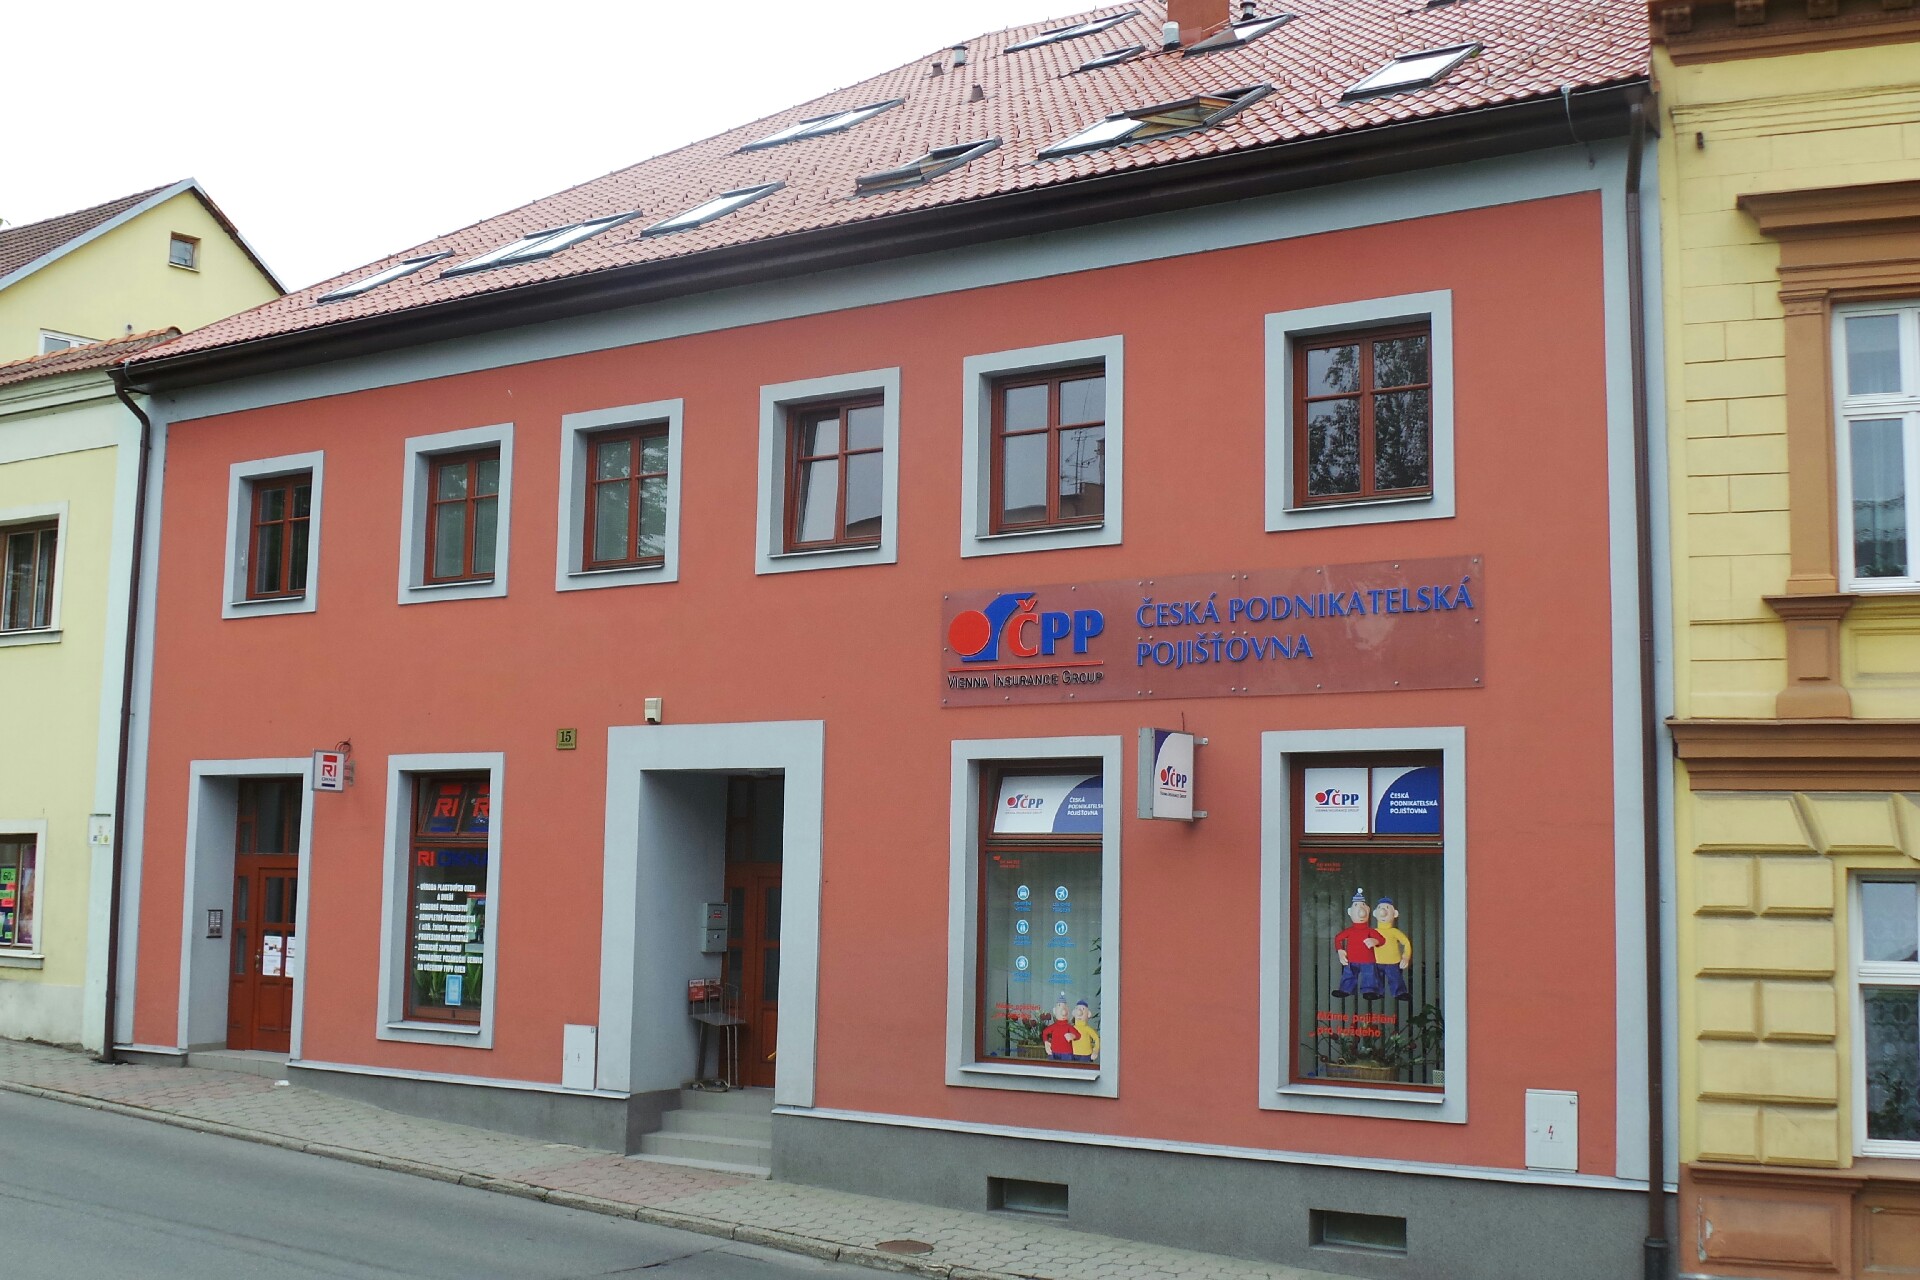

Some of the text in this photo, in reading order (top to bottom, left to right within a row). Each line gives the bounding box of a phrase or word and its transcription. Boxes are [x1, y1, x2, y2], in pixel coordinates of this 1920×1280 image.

[1135, 575, 1474, 628] ČESKÁ PODNIKATELSKÁ
[1007, 599, 1105, 657] ČPP
[1136, 631, 1314, 669] POJIŠŤOVNA
[947, 670, 1104, 689] VIENNA INSURANCE GROUP
[560, 730, 572, 743] 15
[322, 764, 337, 778] RI
[1170, 768, 1188, 789] ČPP
[1020, 795, 1044, 809] ČPP
[1332, 790, 1360, 806] ČPP
[1389, 791, 1410, 799] ČESKÁ
[1389, 799, 1438, 807] PODNIKATELSKÁ
[433, 798, 459, 817] RI
[1389, 807, 1428, 815] POJIŠŤOVNA
[417, 850, 435, 867] RI
